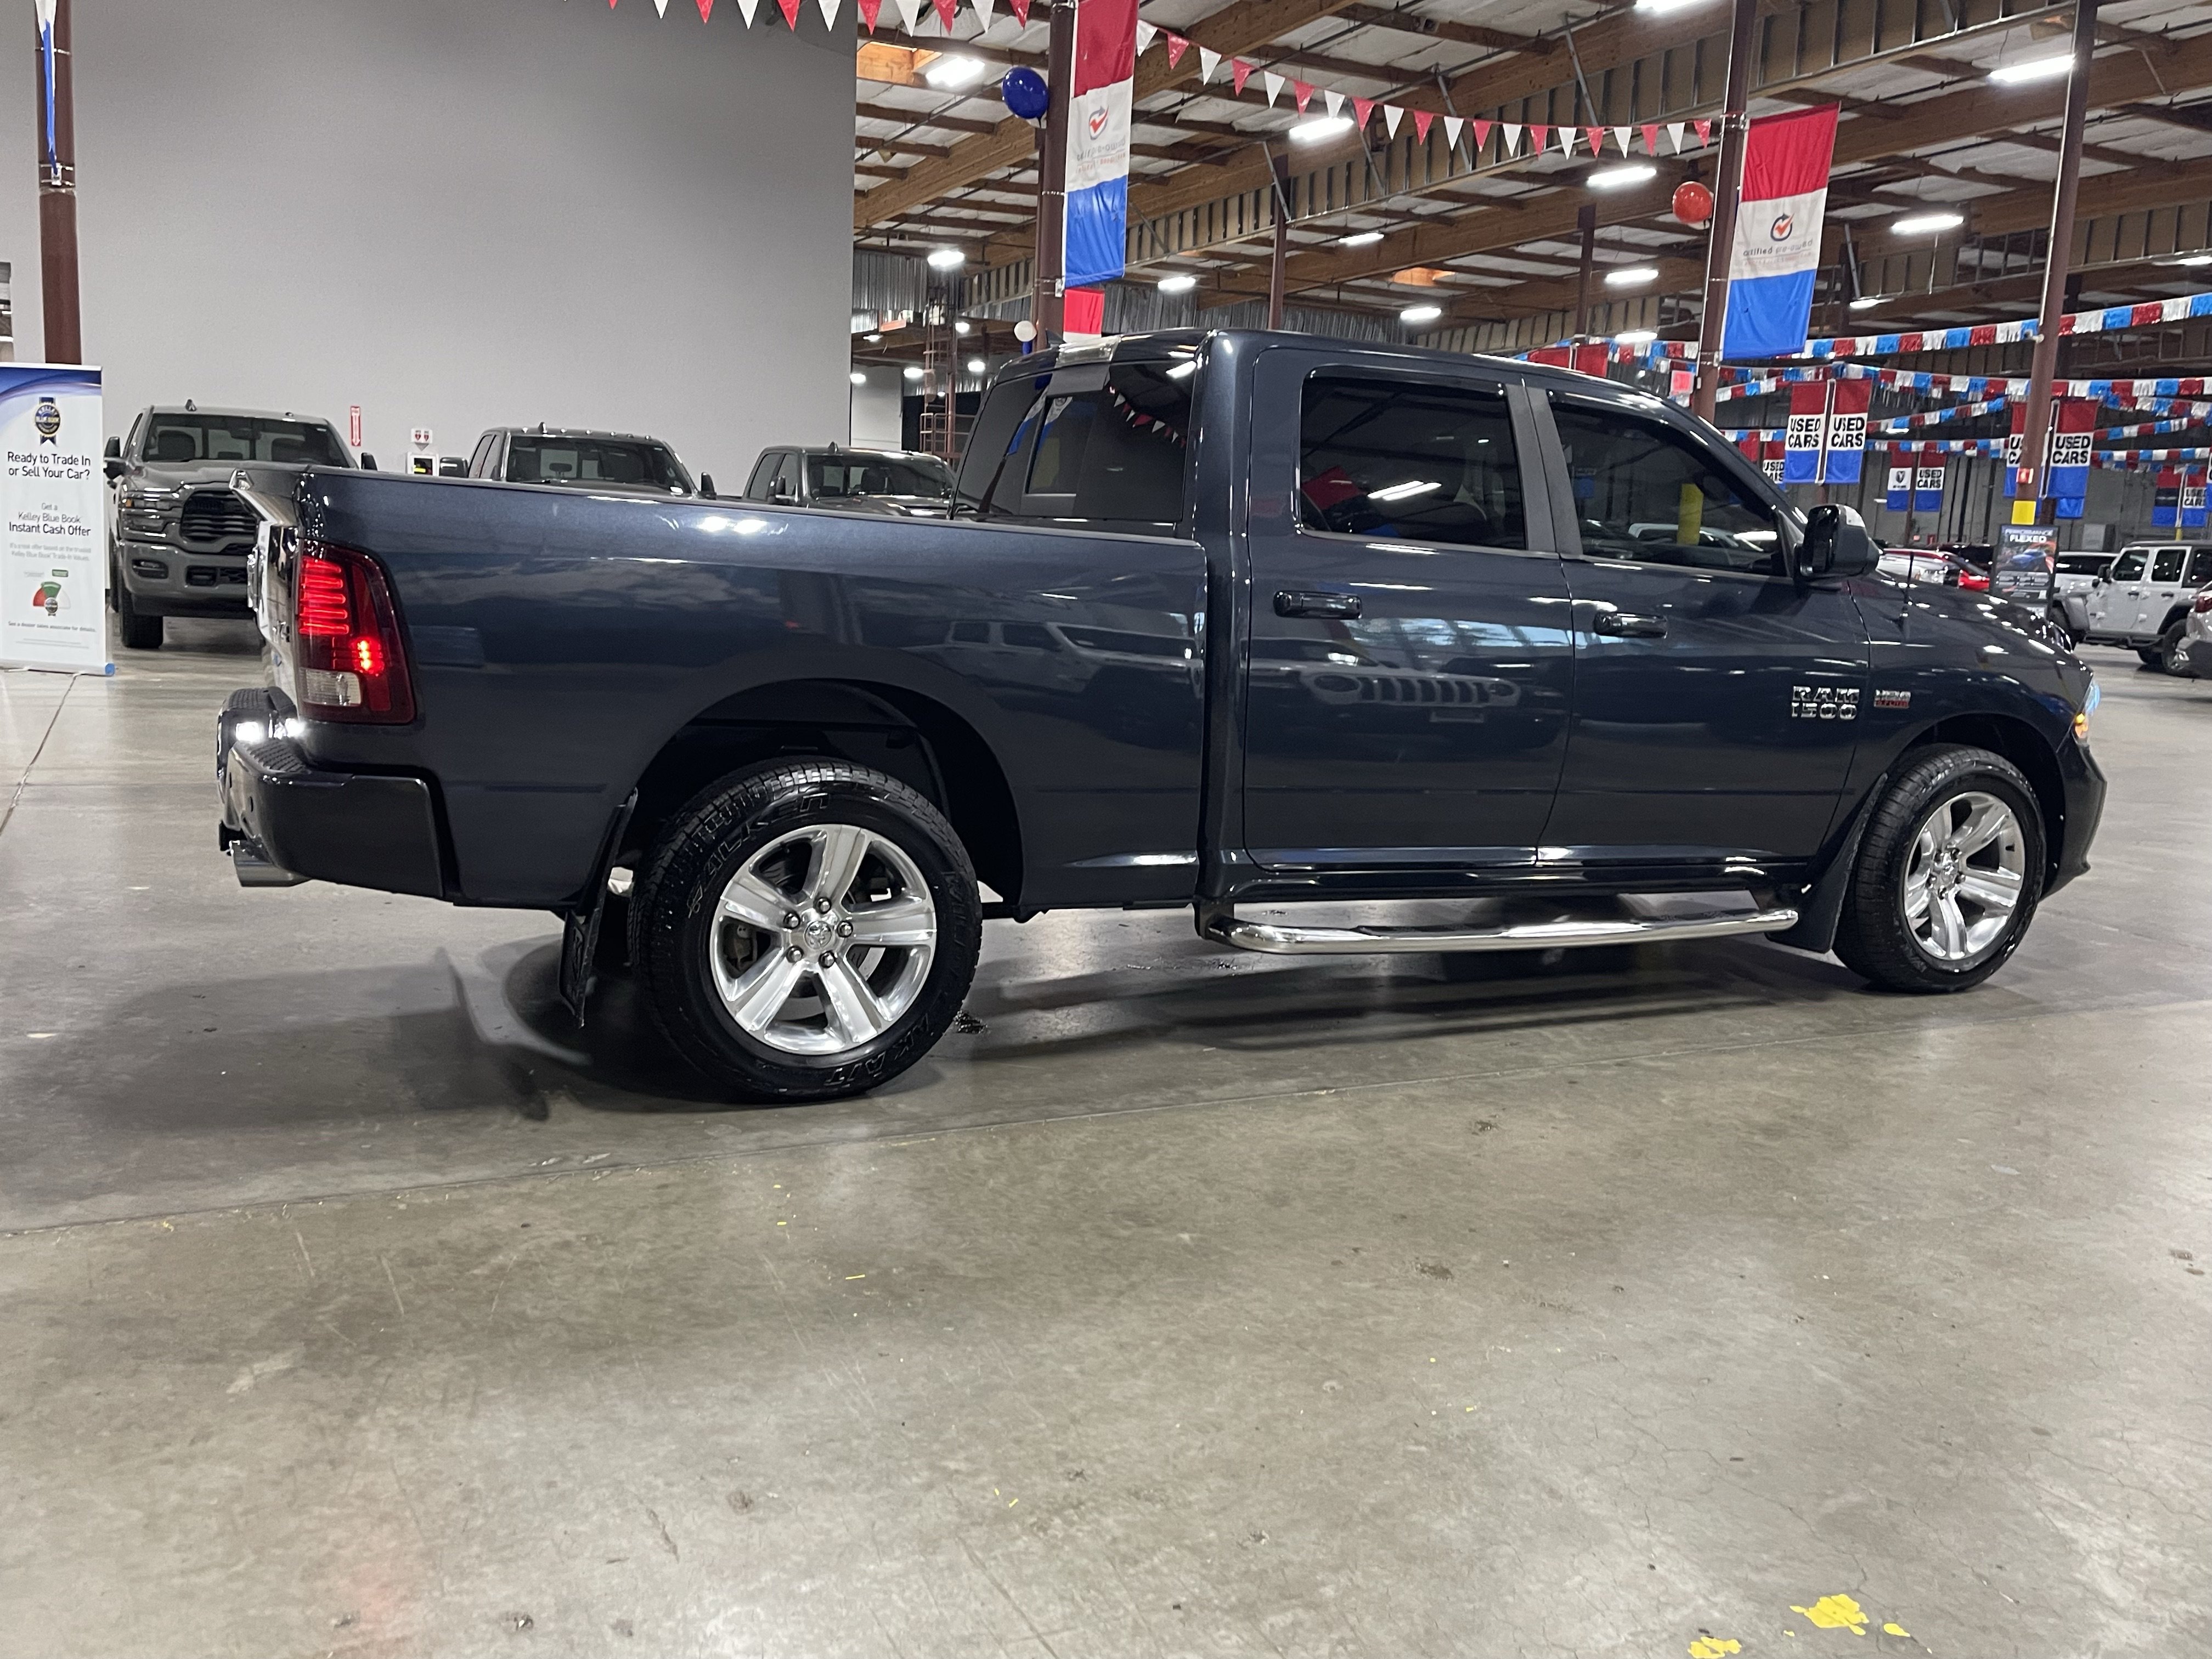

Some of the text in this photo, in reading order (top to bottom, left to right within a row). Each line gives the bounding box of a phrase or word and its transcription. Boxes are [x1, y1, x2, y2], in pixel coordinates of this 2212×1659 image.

[1790, 418, 1821, 432] USED
[1833, 417, 1865, 432] USED
[1788, 434, 1819, 448] CARS
[1831, 433, 1863, 448] CARS
[2055, 436, 2091, 449] USED
[7, 452, 91, 466] Ready to Trade In
[2052, 450, 2089, 464] CARS
[22, 466, 40, 477] Sell
[42, 467, 64, 478] Your
[67, 469, 90, 480] Car?
[1919, 470, 1942, 478] USED
[1917, 479, 1941, 488] CARS
[41, 503, 53, 511] Get
[18, 512, 82, 524] Kelley Blue Book
[9, 522, 91, 537] Instant Cash Offer
[1792, 686, 1860, 703] RAM
[1791, 702, 1857, 720] 1500
